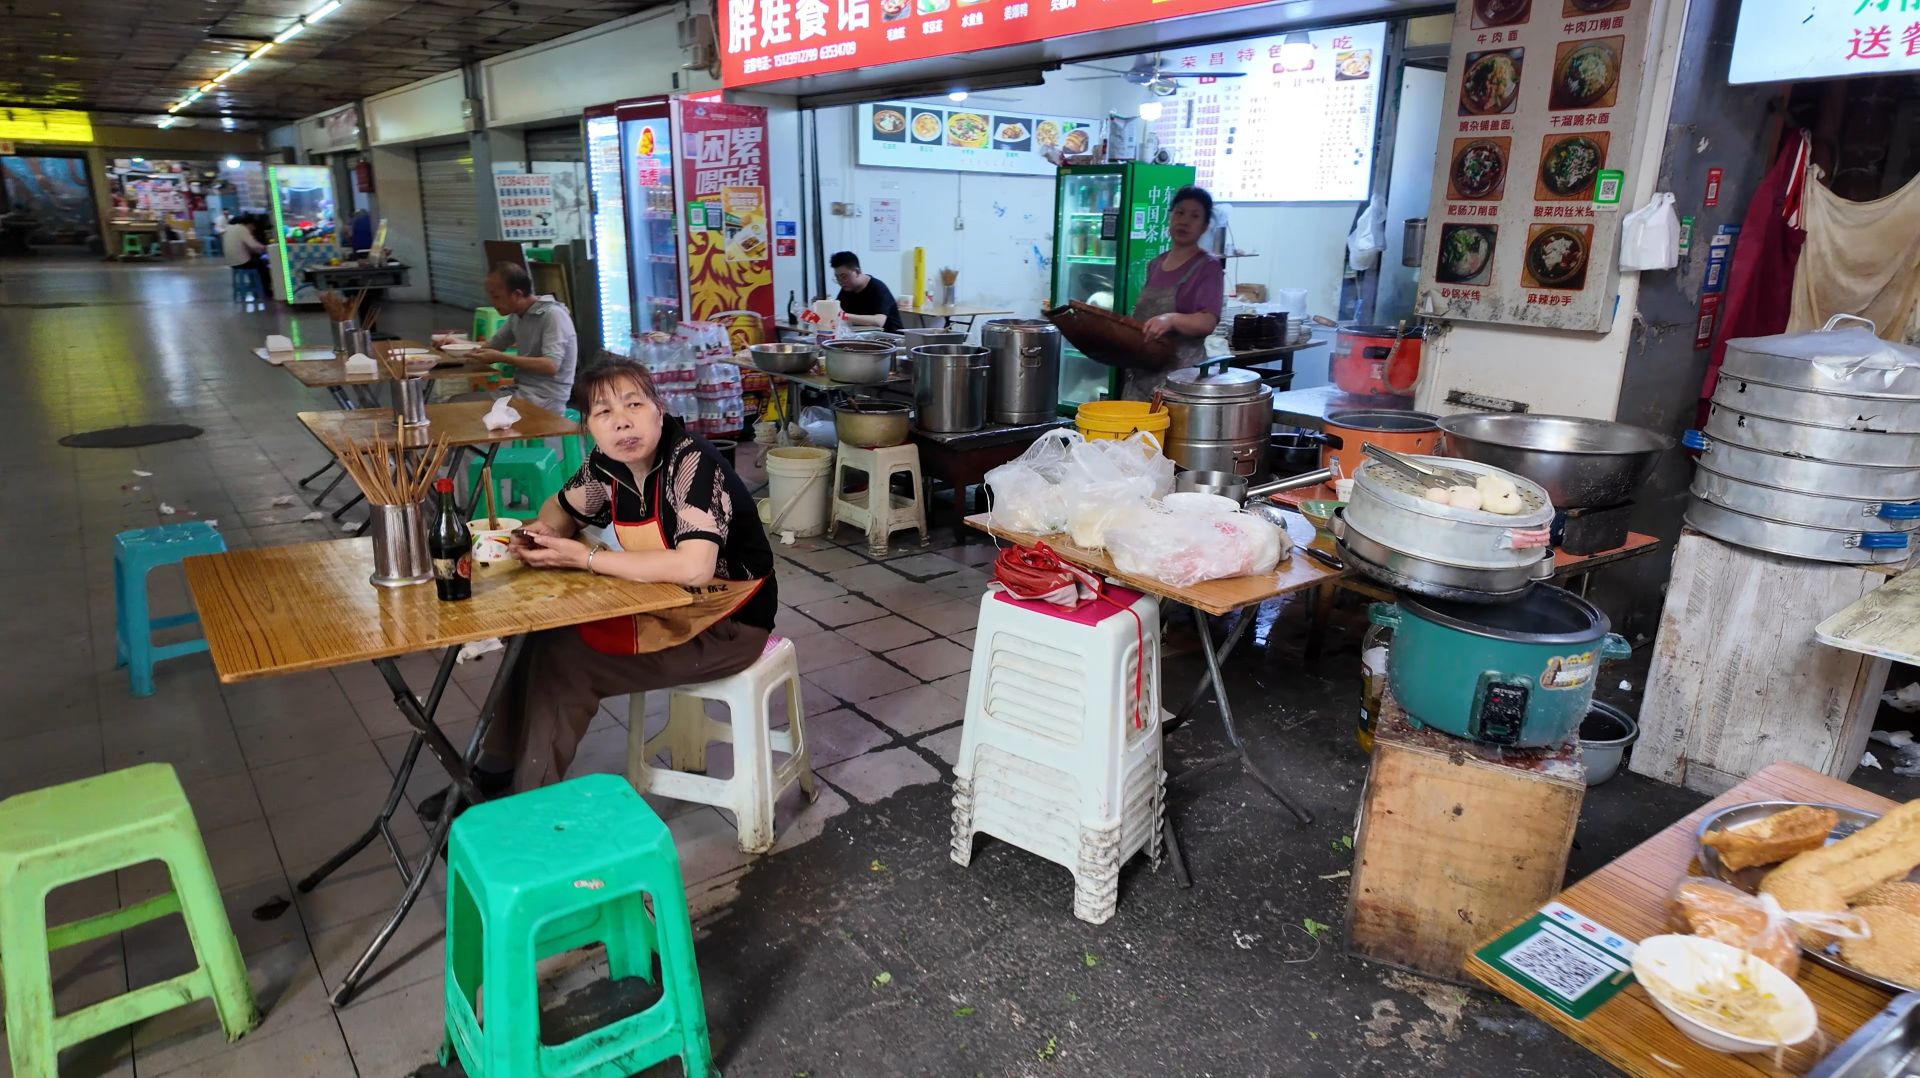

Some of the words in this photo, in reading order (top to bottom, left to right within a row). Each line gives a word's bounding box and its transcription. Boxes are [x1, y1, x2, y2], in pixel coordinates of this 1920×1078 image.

[1563, 16, 1624, 35] 牛肉刀削面
[1477, 30, 1519, 45] 牛肉面
[1181, 35, 1352, 69] 荣昌特色吃
[695, 127, 763, 169] 困累
[1146, 186, 1161, 243] 中国茶
[1447, 205, 1499, 216] 肥肠刀削面
[1441, 287, 1481, 302] 砂锅米线
[1527, 293, 1572, 306] 麻辣抄手
